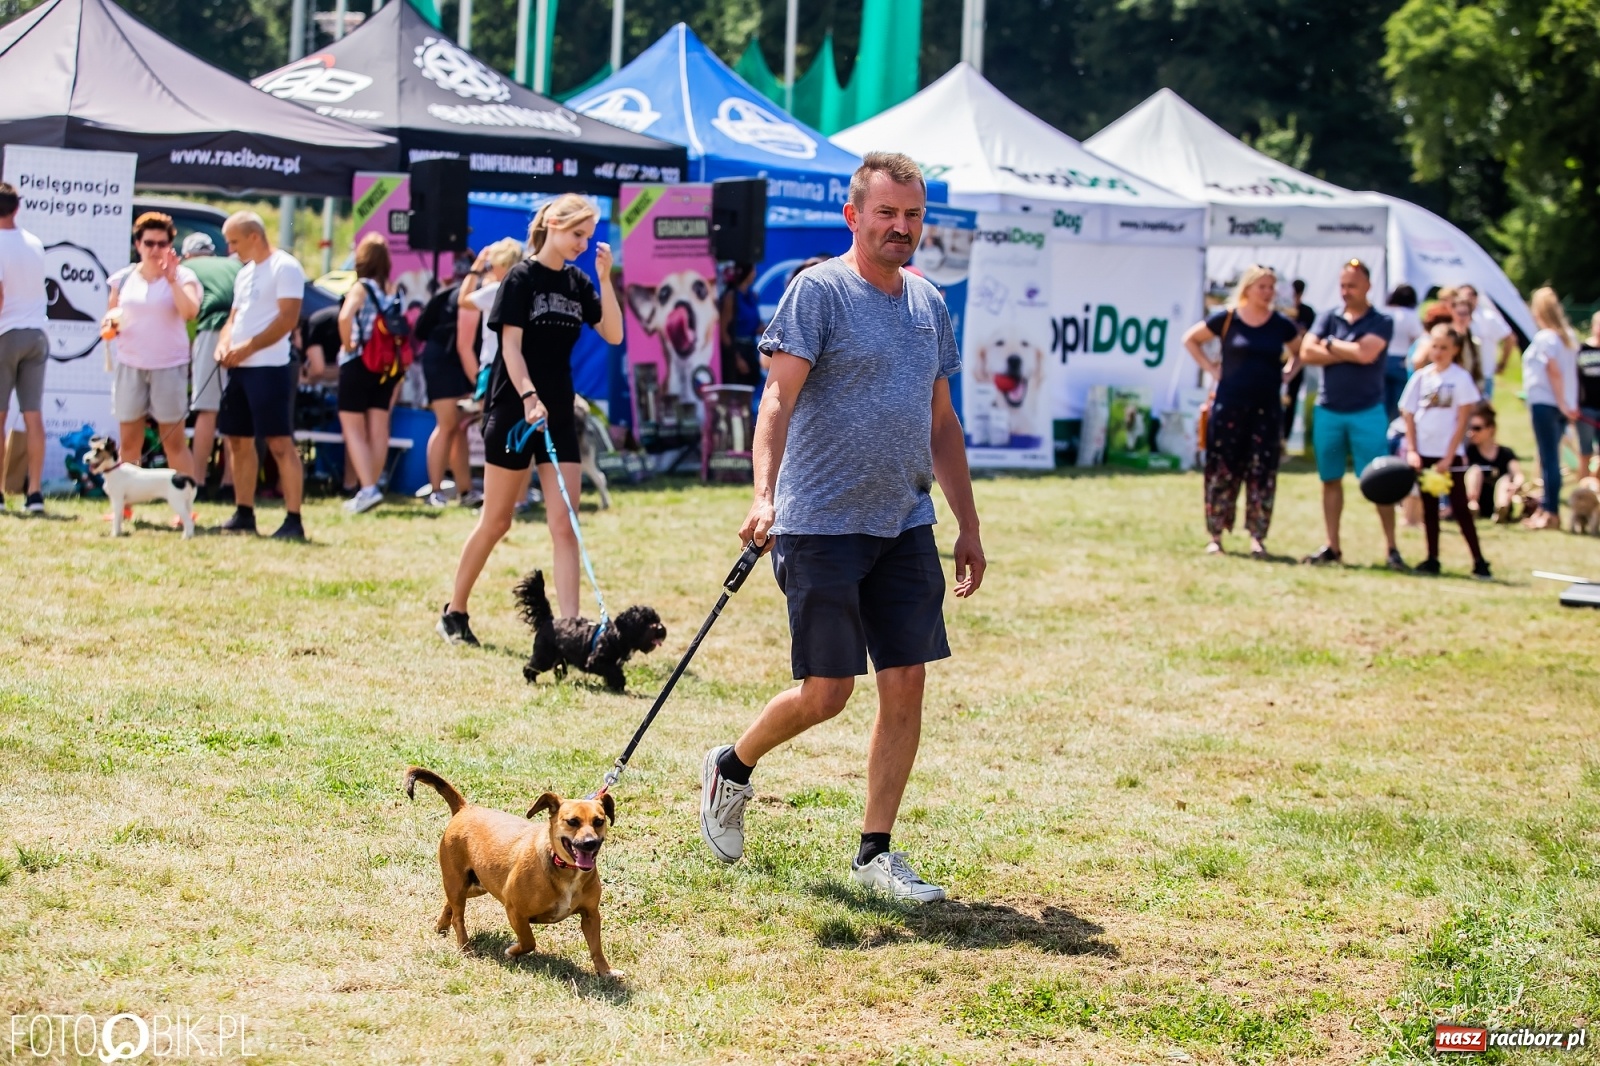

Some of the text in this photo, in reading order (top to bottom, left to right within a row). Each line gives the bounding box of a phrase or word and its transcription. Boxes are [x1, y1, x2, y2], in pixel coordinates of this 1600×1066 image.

[170, 147, 301, 176] www.raciborz.pl
[20, 174, 120, 197] Pielęgnacja
[19, 196, 123, 218] wojego psa
[1228, 215, 1285, 240] TropiDog
[61, 263, 94, 282] Coco
